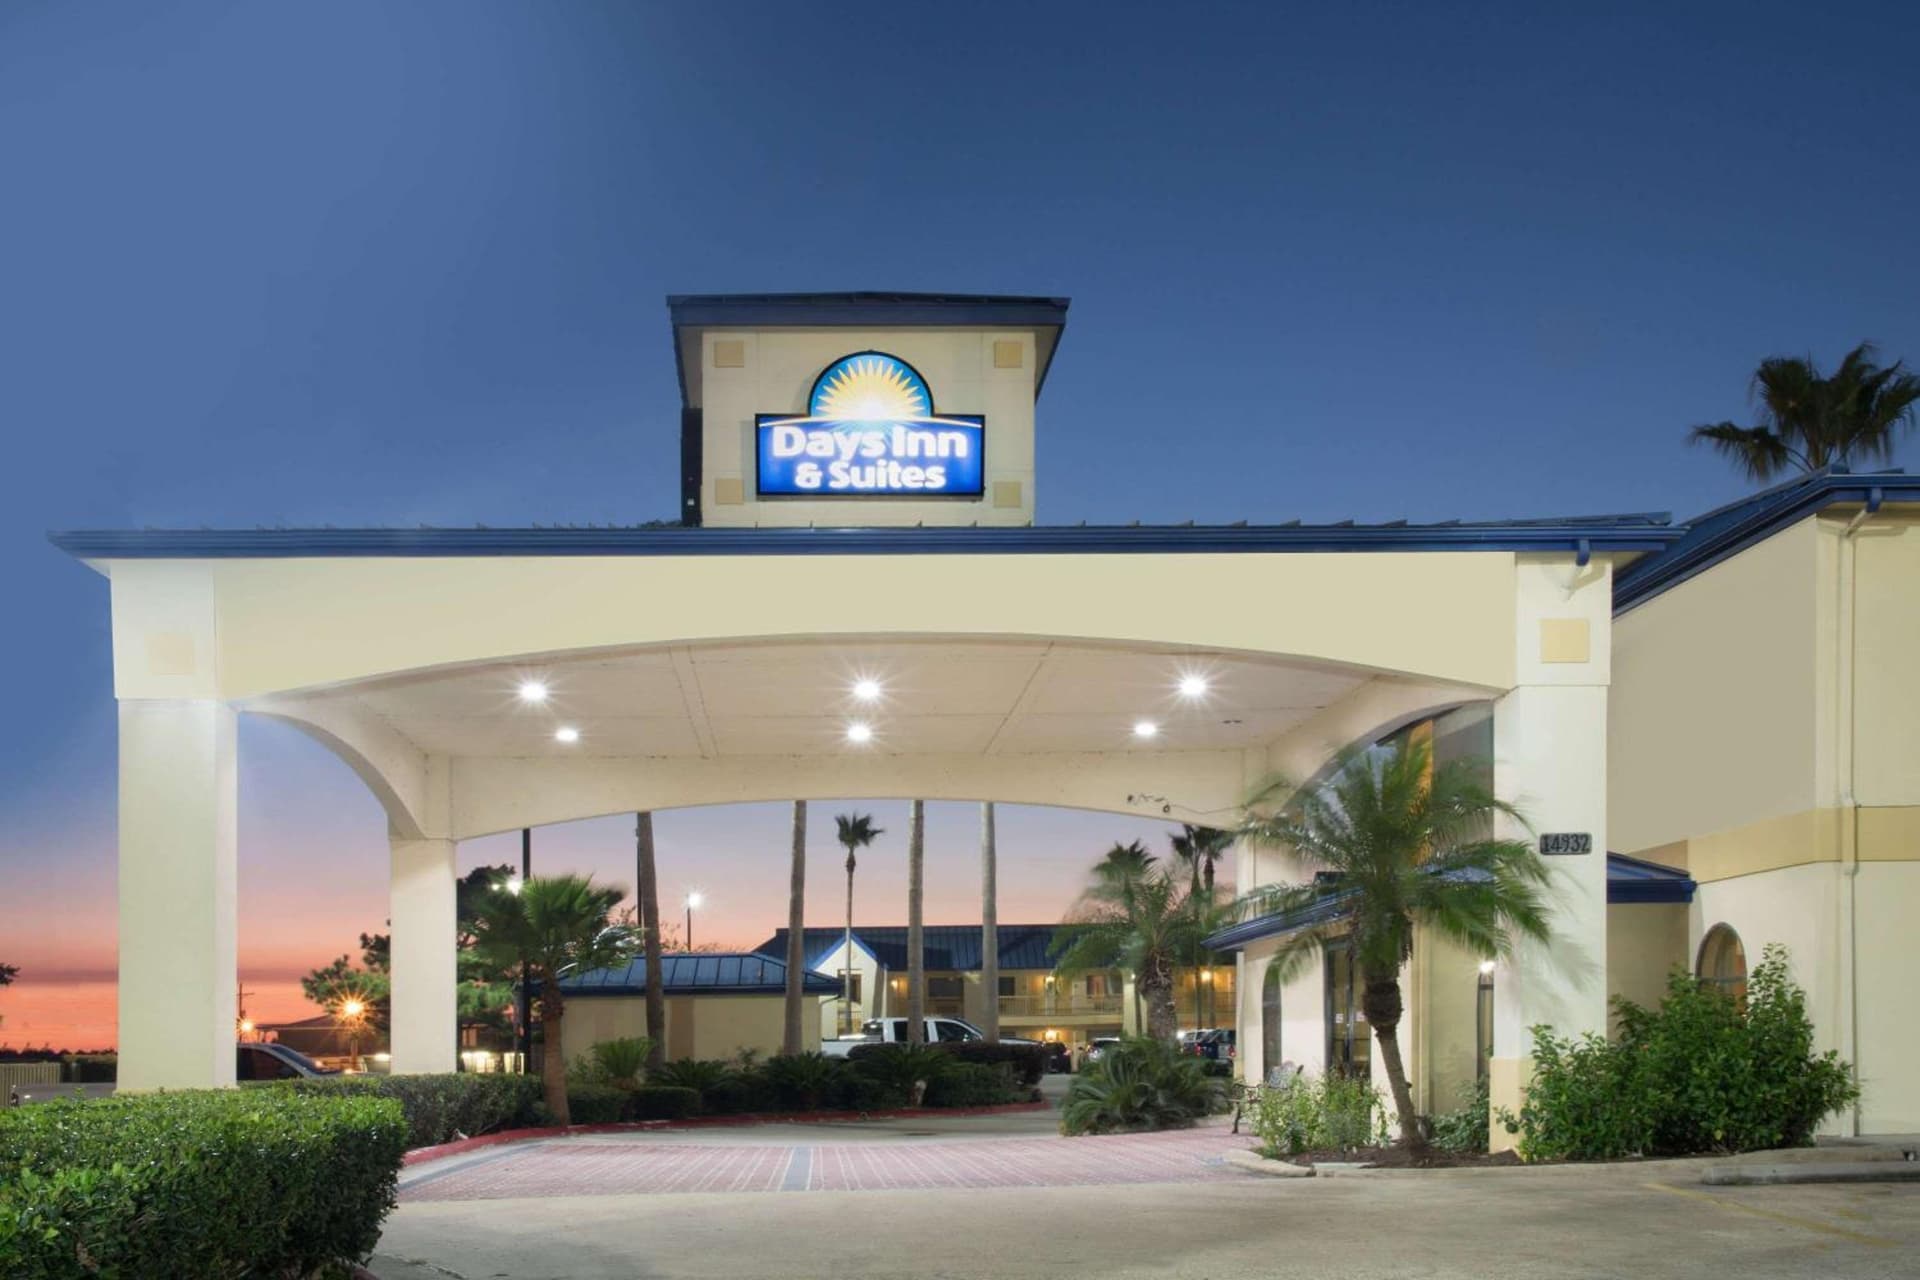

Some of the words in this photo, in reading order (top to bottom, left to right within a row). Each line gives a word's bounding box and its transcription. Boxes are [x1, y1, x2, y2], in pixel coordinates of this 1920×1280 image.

[772, 425, 887, 466] Days
[892, 425, 968, 458] Inn
[794, 462, 823, 489] &
[828, 460, 947, 489] Suites
[1543, 834, 1590, 852] 14932
